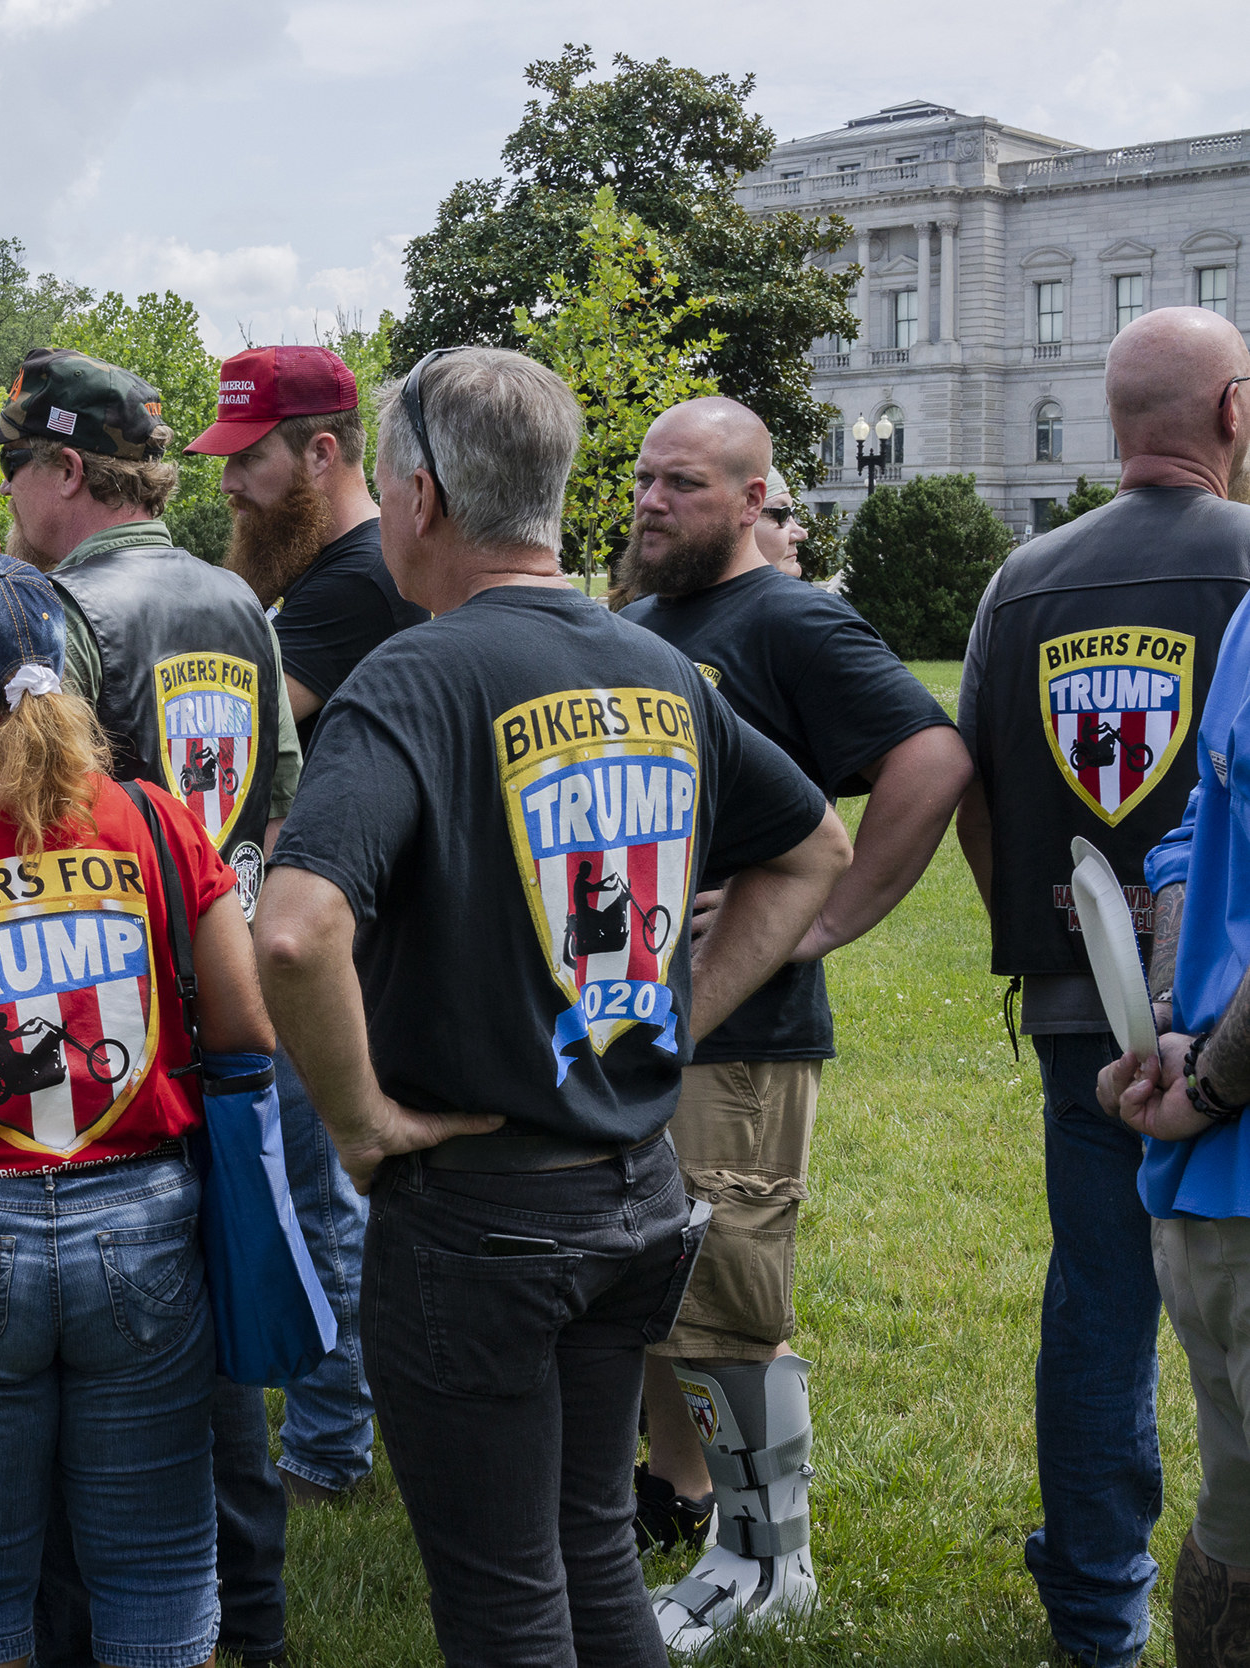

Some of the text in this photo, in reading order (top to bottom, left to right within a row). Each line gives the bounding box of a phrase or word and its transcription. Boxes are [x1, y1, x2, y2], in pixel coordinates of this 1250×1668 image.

[225, 394, 250, 404] AGAIN
[1046, 633, 1188, 670] BIKERS FOR
[160, 659, 253, 693] BIKERS FOR
[702, 666, 720, 682] FOR
[1050, 669, 1174, 711] TRUMP
[166, 695, 249, 735] TRUMP
[502, 697, 695, 766] BIKERS FOR
[525, 764, 693, 848] TRUMP
[57, 856, 146, 894] FOR
